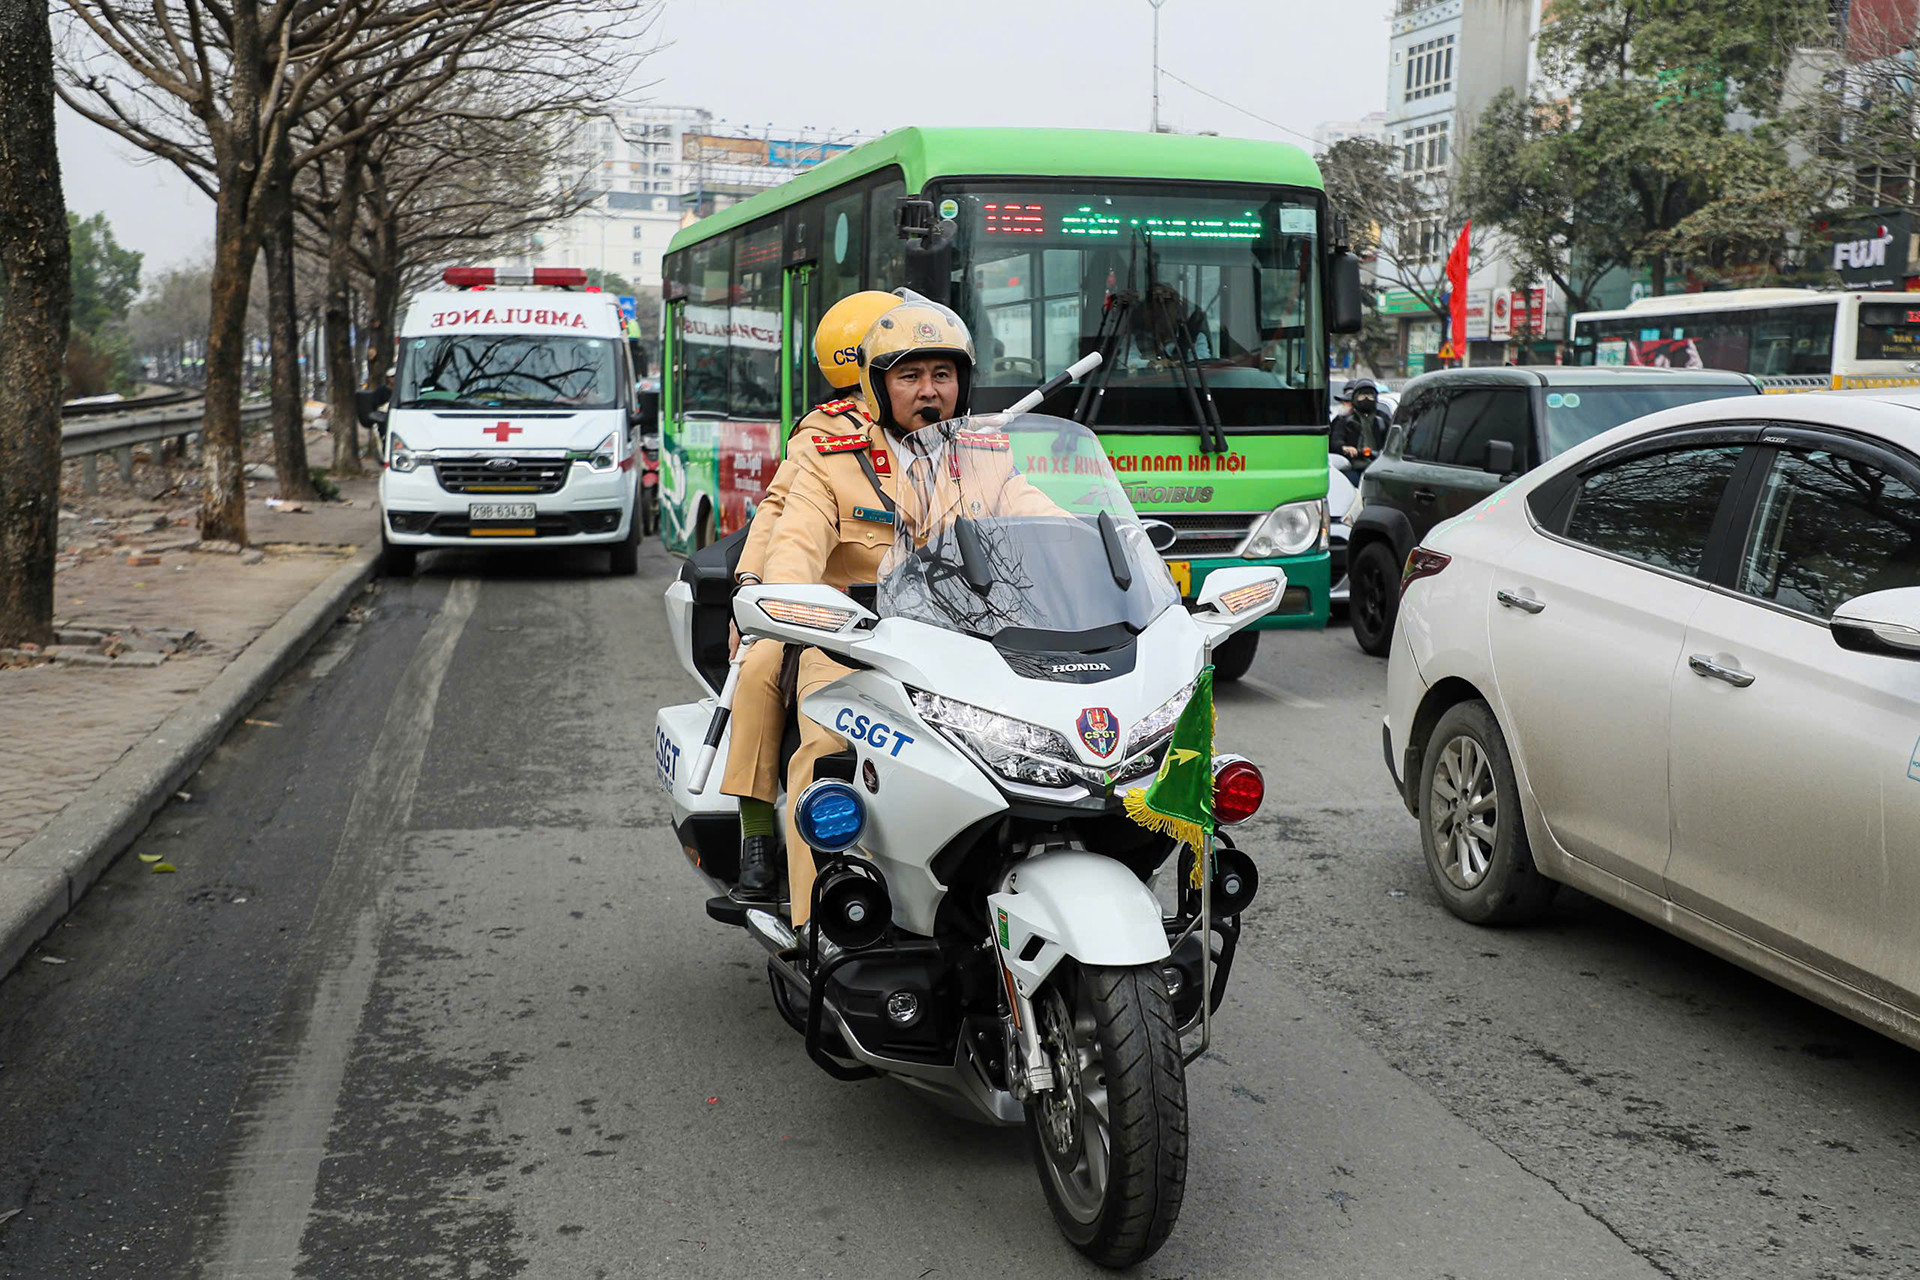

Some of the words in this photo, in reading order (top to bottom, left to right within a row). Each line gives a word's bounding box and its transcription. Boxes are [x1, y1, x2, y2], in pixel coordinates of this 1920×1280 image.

[833, 344, 861, 366] CS
[1141, 454, 1183, 472] NAM
[1215, 451, 1246, 475] NỘI
[1051, 663, 1111, 673] HONDA
